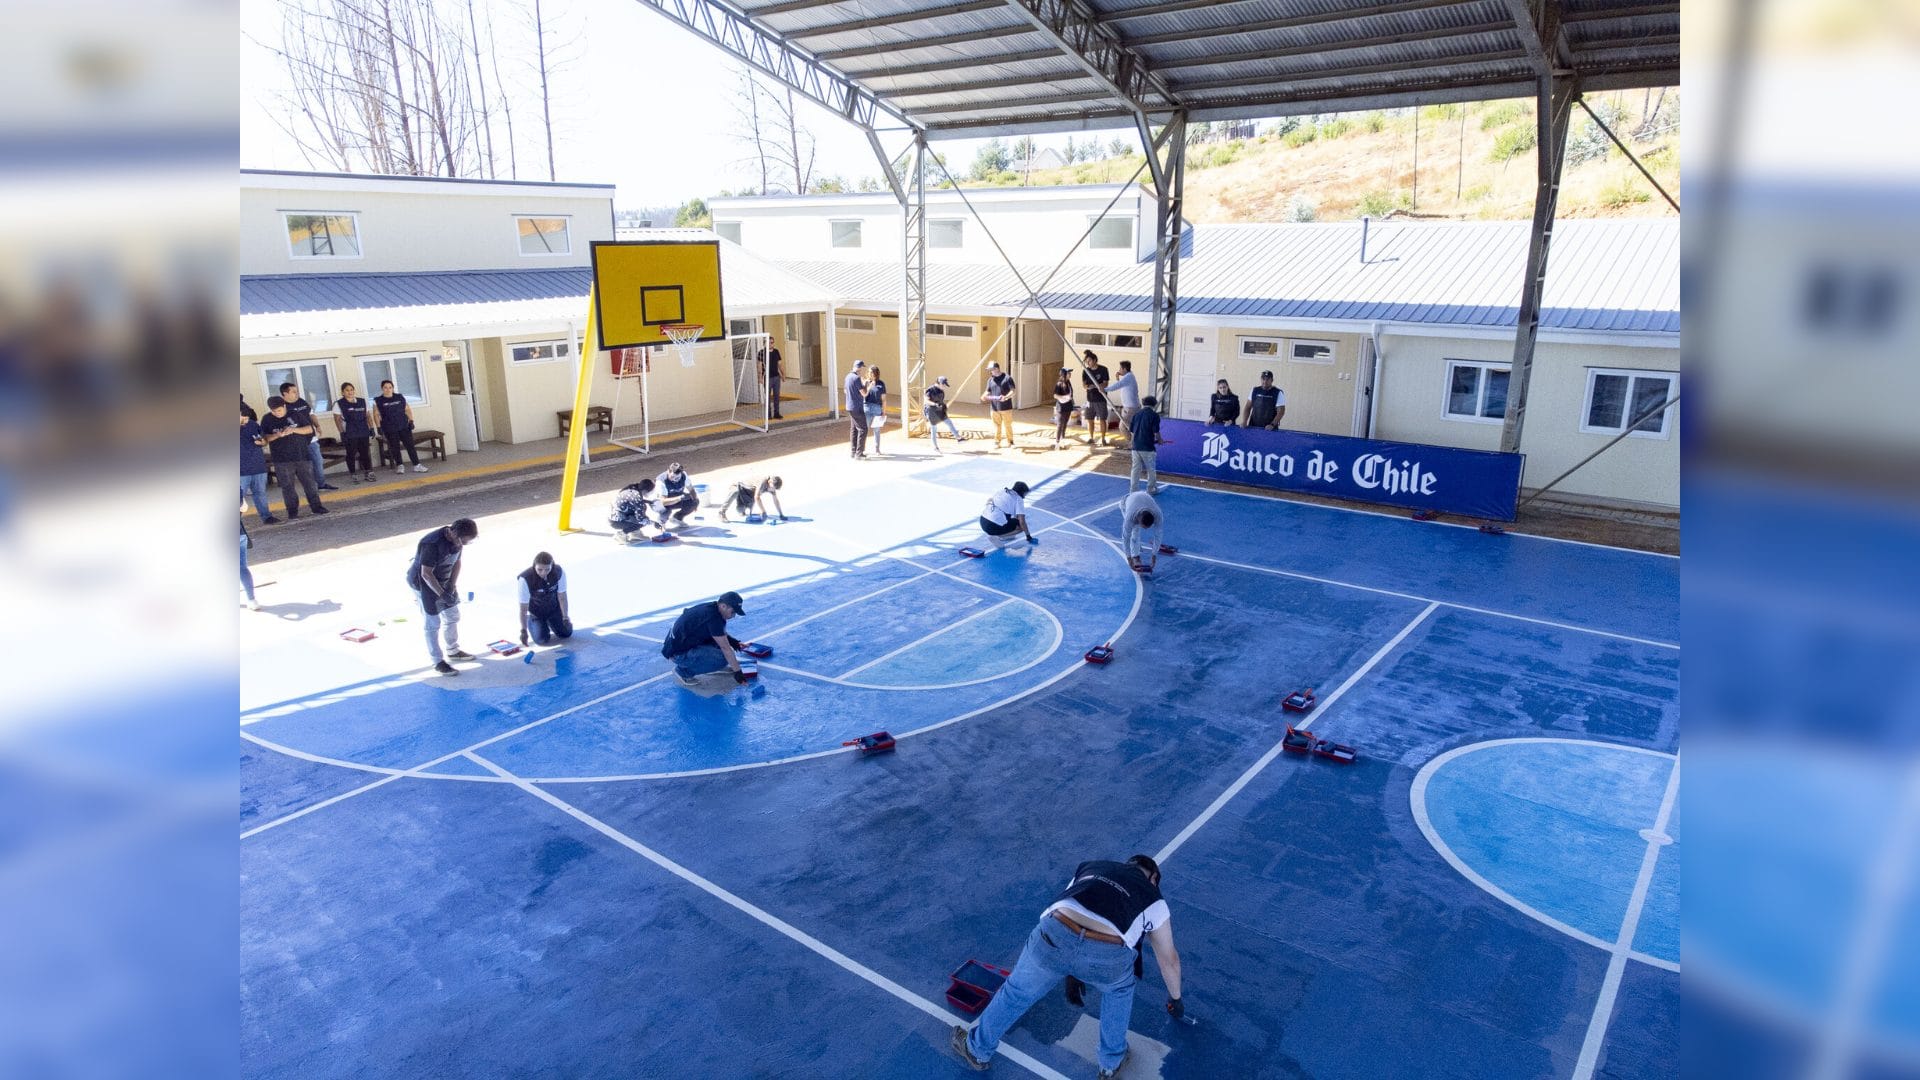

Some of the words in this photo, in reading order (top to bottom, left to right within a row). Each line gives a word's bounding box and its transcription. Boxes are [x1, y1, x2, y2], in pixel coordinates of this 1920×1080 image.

[1200, 432, 1294, 477] Banco
[1306, 450, 1339, 483] de
[1351, 453, 1437, 496] Chile
